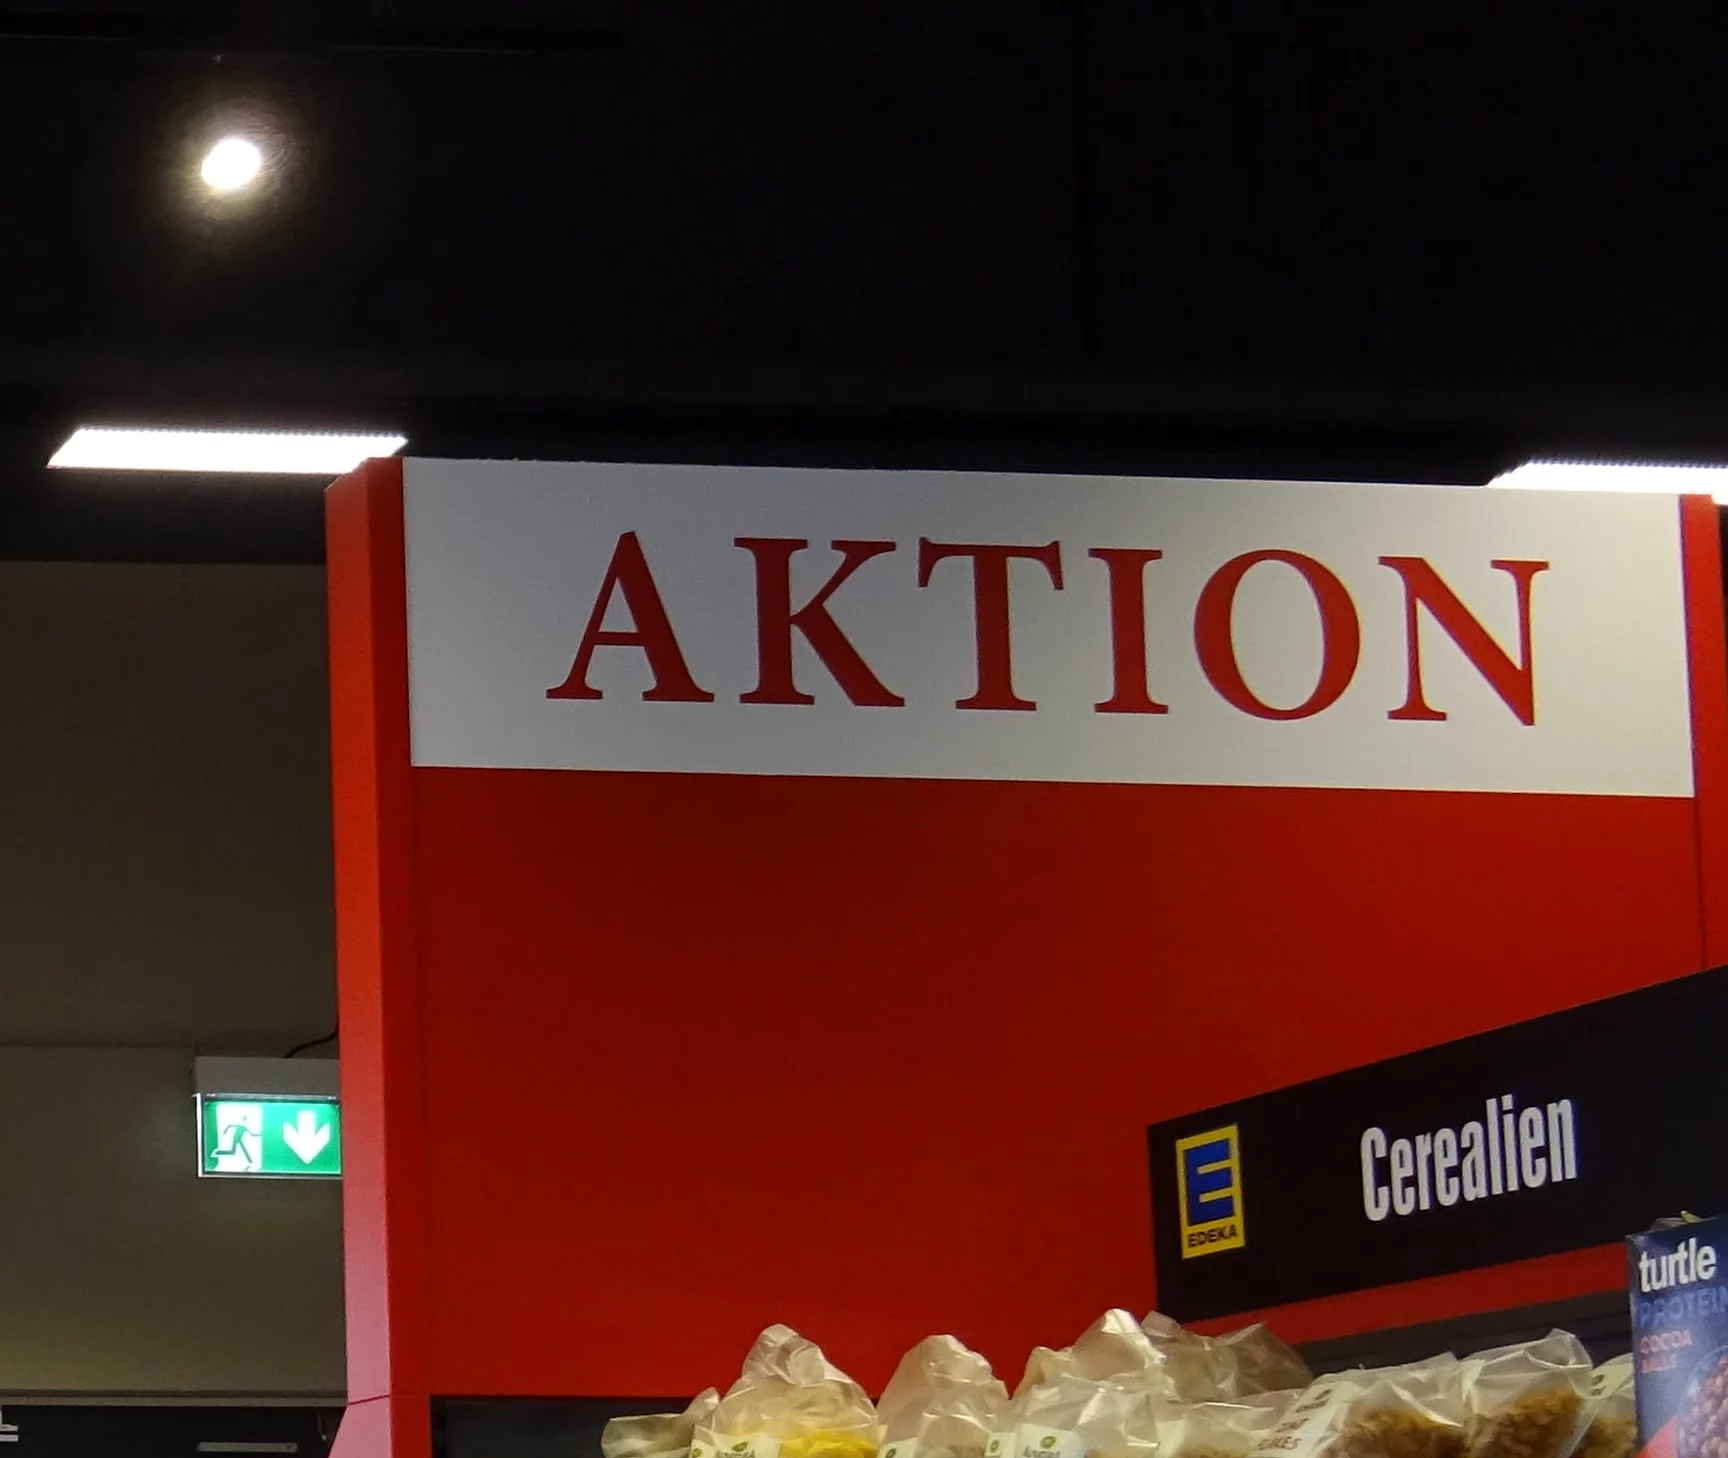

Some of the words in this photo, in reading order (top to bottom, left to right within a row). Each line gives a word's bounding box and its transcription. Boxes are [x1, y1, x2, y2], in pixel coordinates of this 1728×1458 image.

[546, 529, 1551, 727] AKTION
[1360, 1094, 1577, 1222] Cerealien
[1187, 1224, 1238, 1249] EDEKA
[1639, 1237, 1717, 1293] turtle
